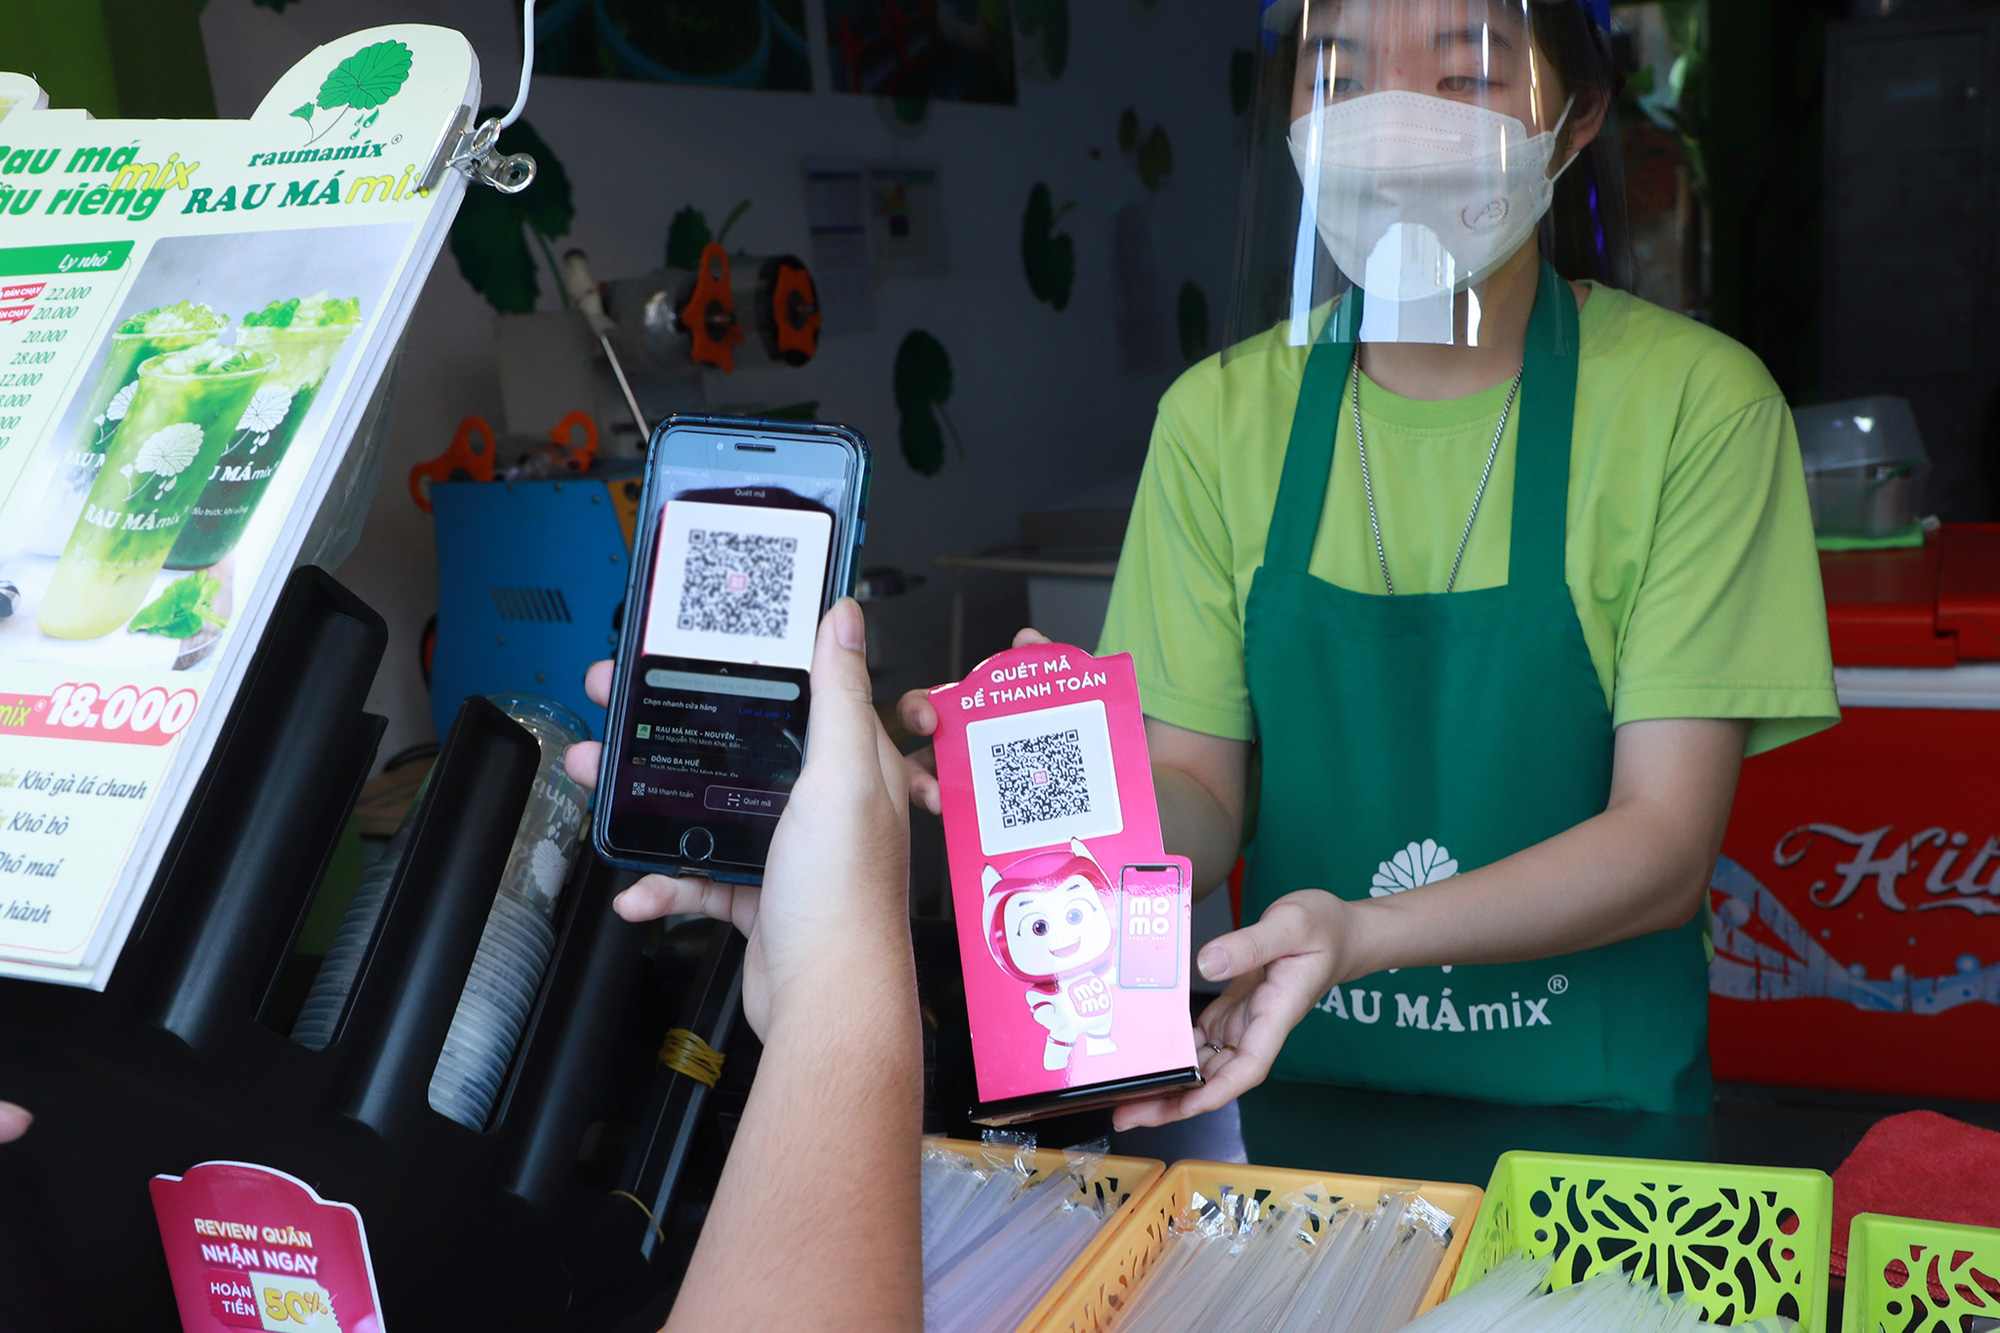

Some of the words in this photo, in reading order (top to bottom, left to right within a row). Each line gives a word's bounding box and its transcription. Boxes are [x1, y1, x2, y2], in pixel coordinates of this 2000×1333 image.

[109, 153, 200, 192] mix
[44, 183, 166, 222] riêng
[180, 182, 273, 215] RAU
[58, 253, 78, 272] Ly
[77, 250, 112, 268] nhỏ
[45, 286, 92, 300] 22.000
[32, 306, 80, 320] 20.000
[21, 329, 68, 343] 20.000
[9, 351, 56, 365] 28.000
[735, 488, 753, 498] Quét
[753, 489, 766, 498] mã
[84, 504, 123, 529] RAU
[990, 662, 1039, 683] QUÉT
[1043, 655, 1071, 675] MÃ
[961, 687, 986, 710] ĐỂ
[989, 682, 1052, 705] THANH
[1056, 672, 1108, 693] TOÁN
[46, 683, 197, 735] 18.000
[643, 697, 661, 707] Chọn
[662, 699, 684, 709] nhanh
[699, 703, 718, 713] hàng
[655, 725, 670, 734] RAU
[671, 725, 684, 735] MÁ
[684, 728, 698, 737] MIX
[698, 738, 713, 746] Minh
[672, 756, 684, 765] BA
[18, 769, 54, 791] Khô
[49, 774, 76, 796] gà
[76, 775, 98, 795] lá
[96, 778, 148, 800] chanh
[647, 786, 659, 795] Mã
[659, 787, 678, 797] thanh
[679, 789, 694, 798] toán
[743, 797, 760, 806] Quét
[761, 799, 772, 807] mã
[7, 811, 47, 831] Khô
[44, 815, 69, 835] bò
[23, 858, 65, 878] mai
[3, 900, 52, 924] hành
[1313, 984, 1383, 1025] AU
[194, 1218, 258, 1242] REVIEW
[262, 1225, 313, 1248] QUÁN
[201, 1242, 260, 1269] NHẬN
[263, 1251, 319, 1275] NGAY
[210, 1281, 252, 1299] HOÀN
[222, 1299, 256, 1317] TIỀN
[263, 1287, 329, 1325] 50%
